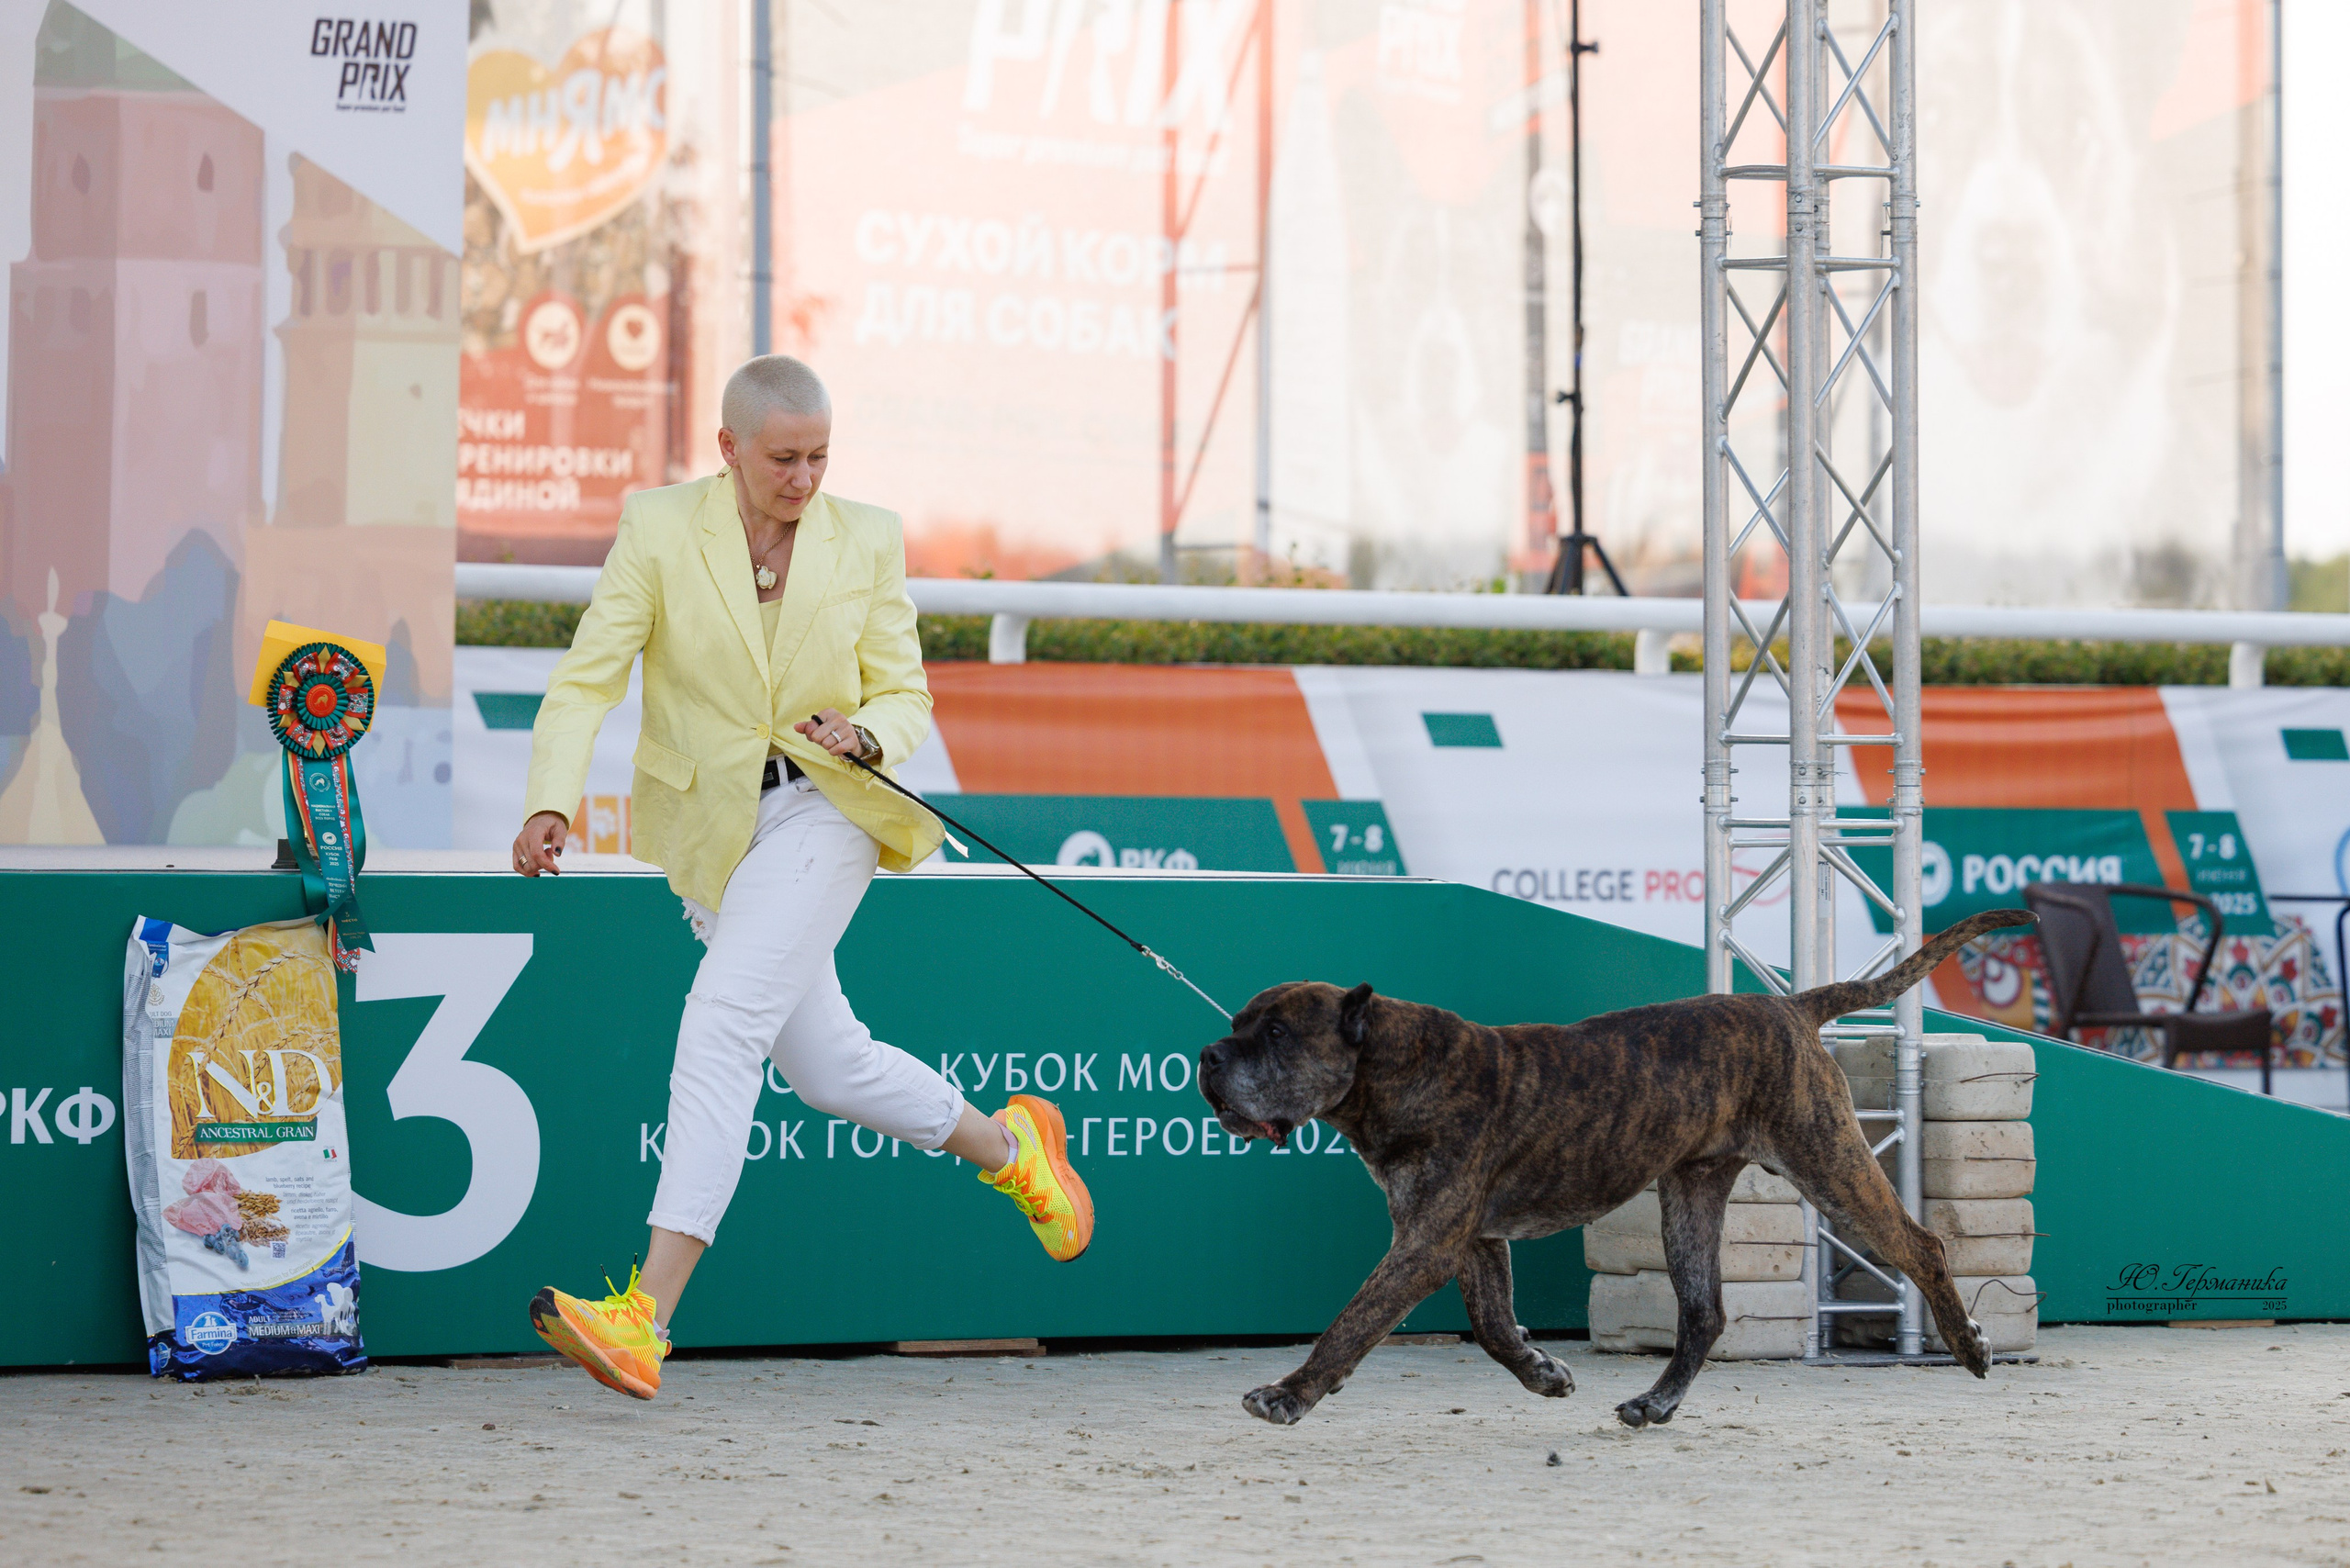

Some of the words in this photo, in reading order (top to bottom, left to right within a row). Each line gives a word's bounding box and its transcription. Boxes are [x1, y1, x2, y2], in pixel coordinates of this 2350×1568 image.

[310, 18, 417, 60] GRAND
[338, 62, 410, 102] PRIX
[854, 207, 1057, 281] СУХОЙ
[855, 282, 975, 349] ДЛЯ
[987, 294, 1179, 362] СОБАК
[1492, 868, 1636, 902] COLLEGE
[1644, 869, 1706, 903] PRO
[1962, 854, 2122, 895] РОССИЯ
[186, 1049, 333, 1119] N&D
[941, 1052, 1099, 1092] КУБОК
[1118, 1052, 1201, 1092] МО
[351, 933, 541, 1272] 3
[200, 1126, 274, 1139] ANCESTRAL
[276, 1126, 314, 1138] GRAIN
[640, 1119, 806, 1162] КОК
[191, 1327, 232, 1340] Farmina
[249, 1315, 271, 1323] ADULT
